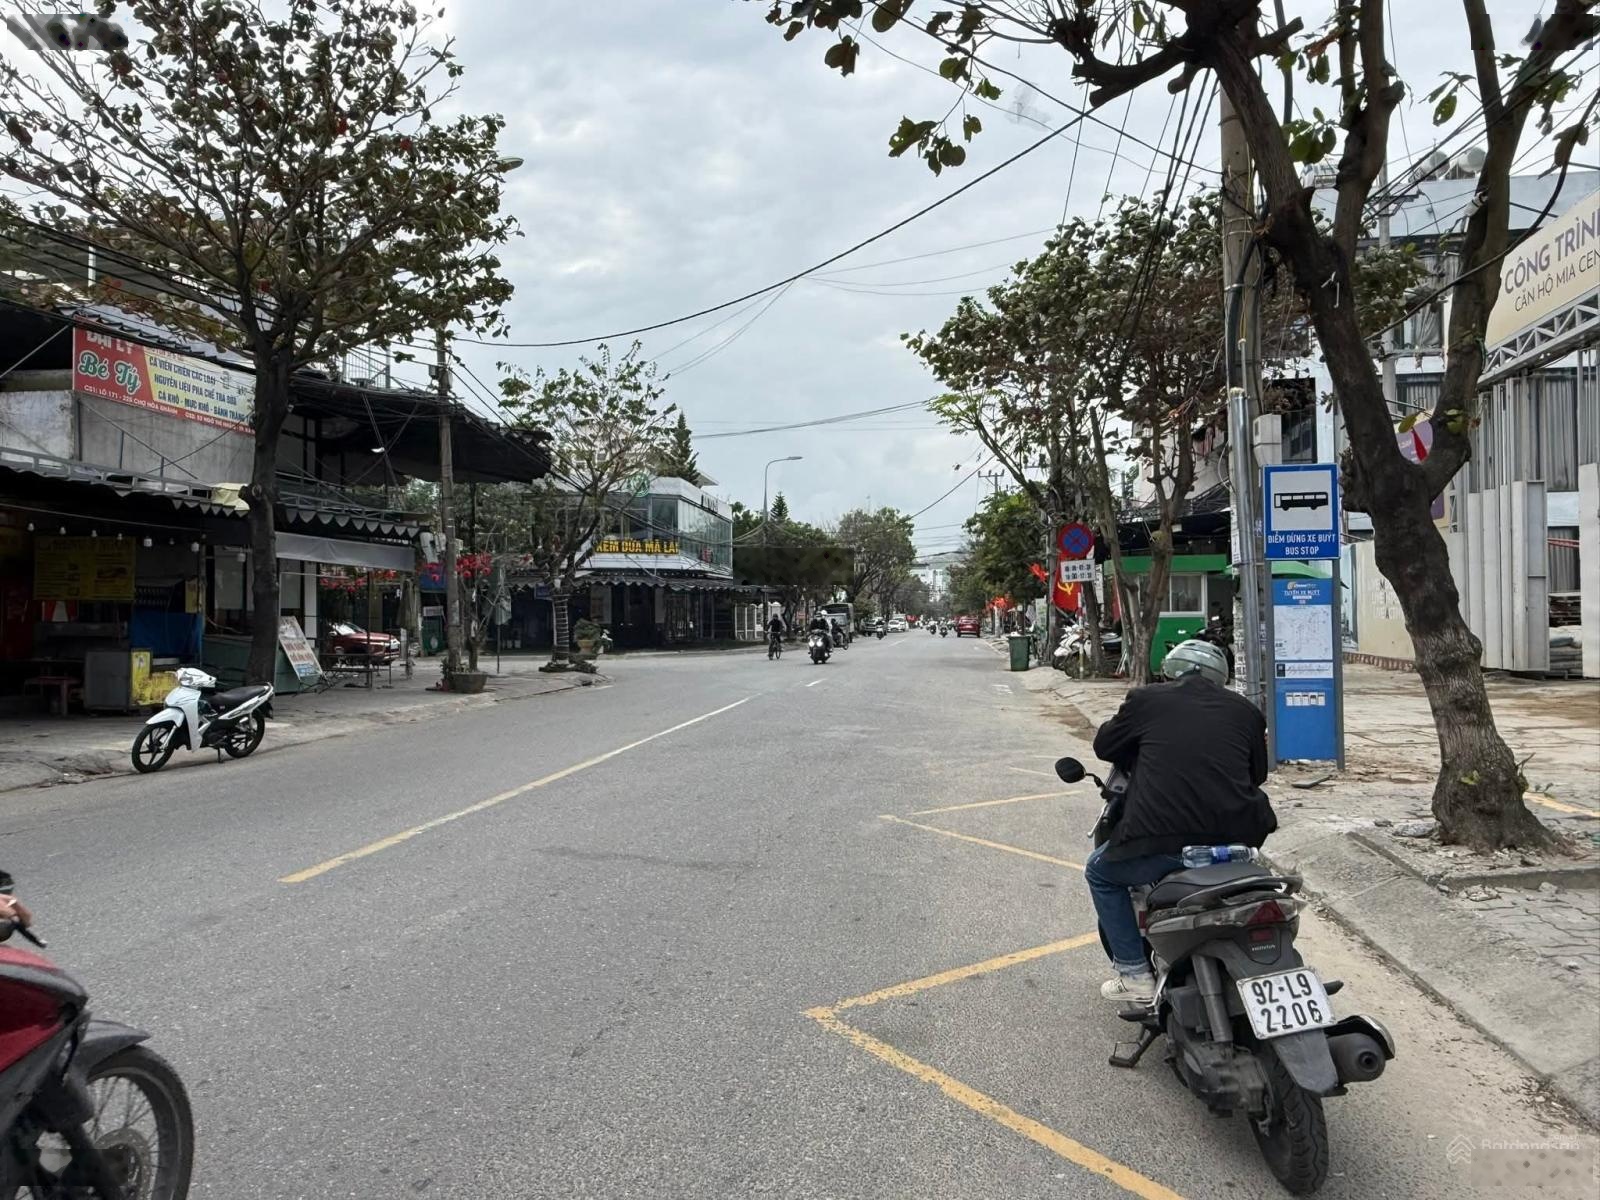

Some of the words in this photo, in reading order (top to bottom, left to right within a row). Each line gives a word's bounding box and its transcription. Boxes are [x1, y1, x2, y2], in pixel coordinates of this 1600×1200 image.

[1504, 243, 1551, 294] CÔNG
[1514, 287, 1535, 312] CĂN
[1537, 273, 1554, 299] HỘ
[1556, 263, 1576, 288] MIA
[78, 350, 110, 380] Bé
[1285, 546, 1300, 555] BUS
[1300, 545, 1320, 555] STOP
[1307, 534, 1317, 543] XE
[1251, 973, 1312, 1005] 92-L9
[1260, 999, 1323, 1033] 2206
